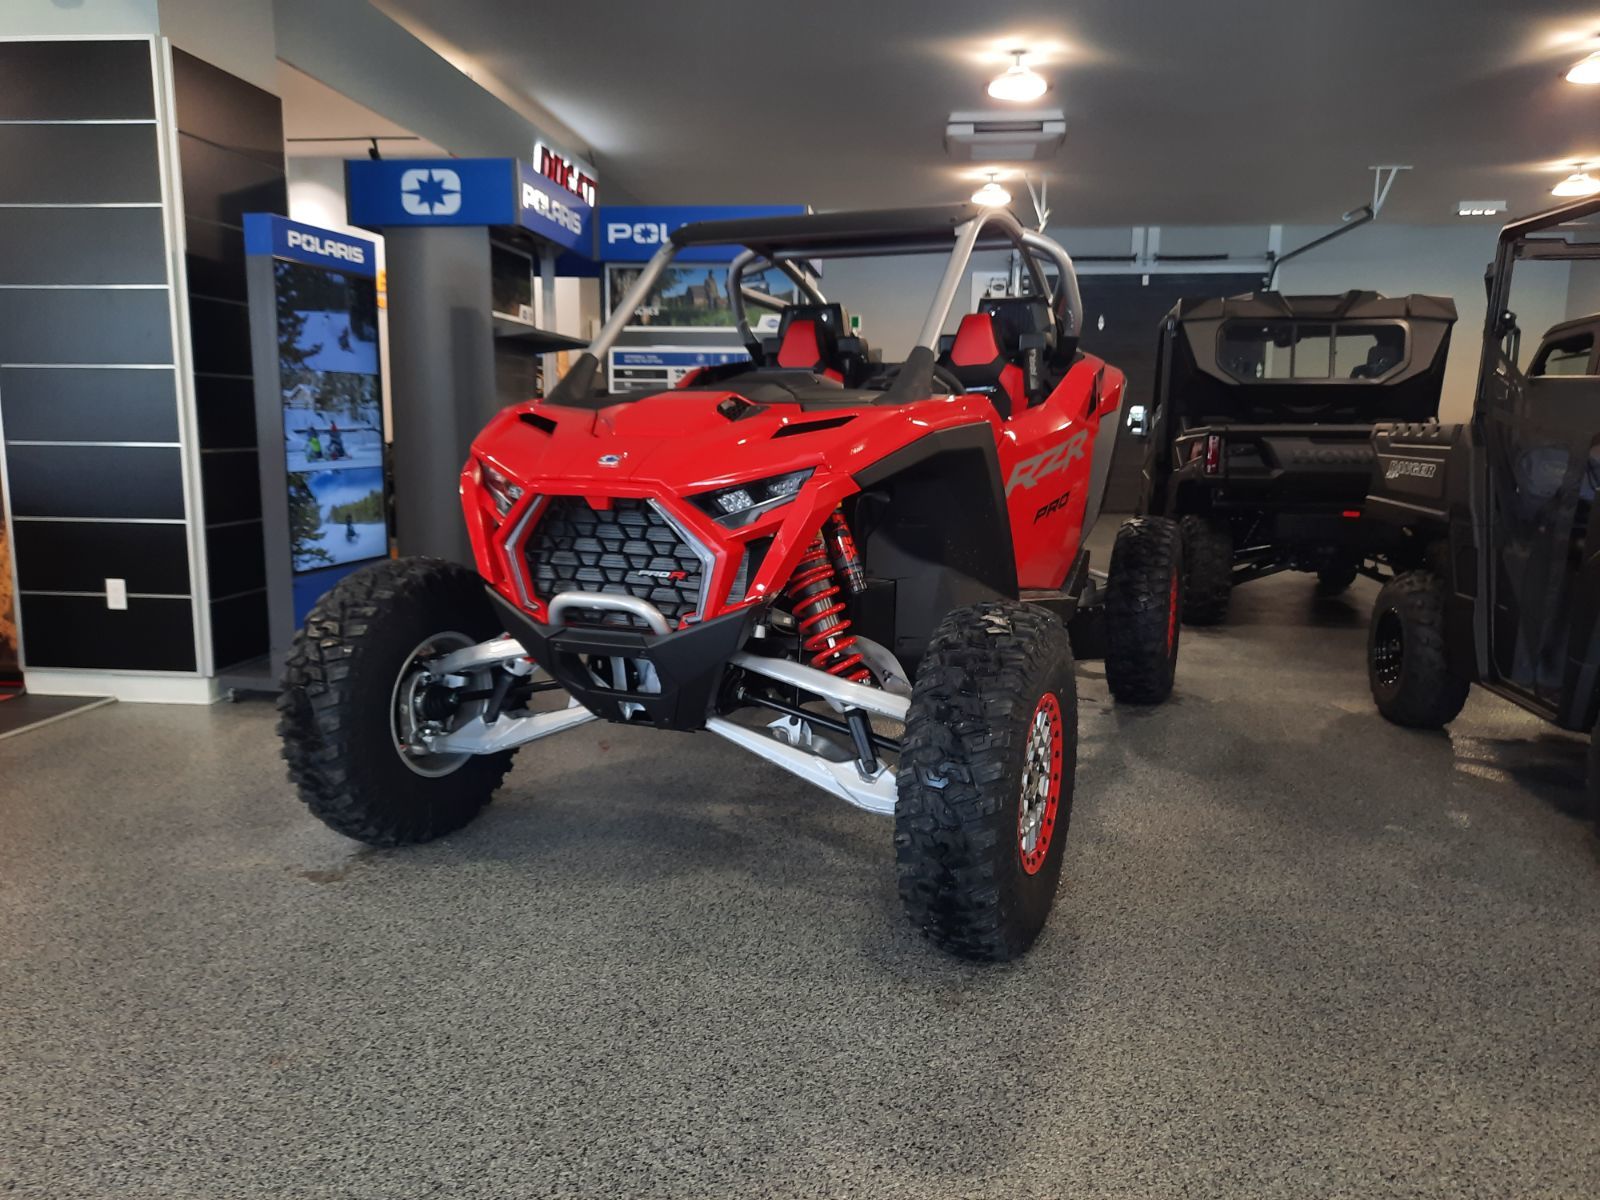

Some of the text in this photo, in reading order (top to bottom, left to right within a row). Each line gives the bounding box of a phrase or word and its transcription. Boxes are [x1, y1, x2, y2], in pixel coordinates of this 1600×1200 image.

[522, 181, 583, 237] POLARIS
[285, 229, 366, 265] POLARIS
[607, 222, 671, 245] POL
[1005, 427, 1089, 498] RZR
[1033, 490, 1072, 524] PRO
